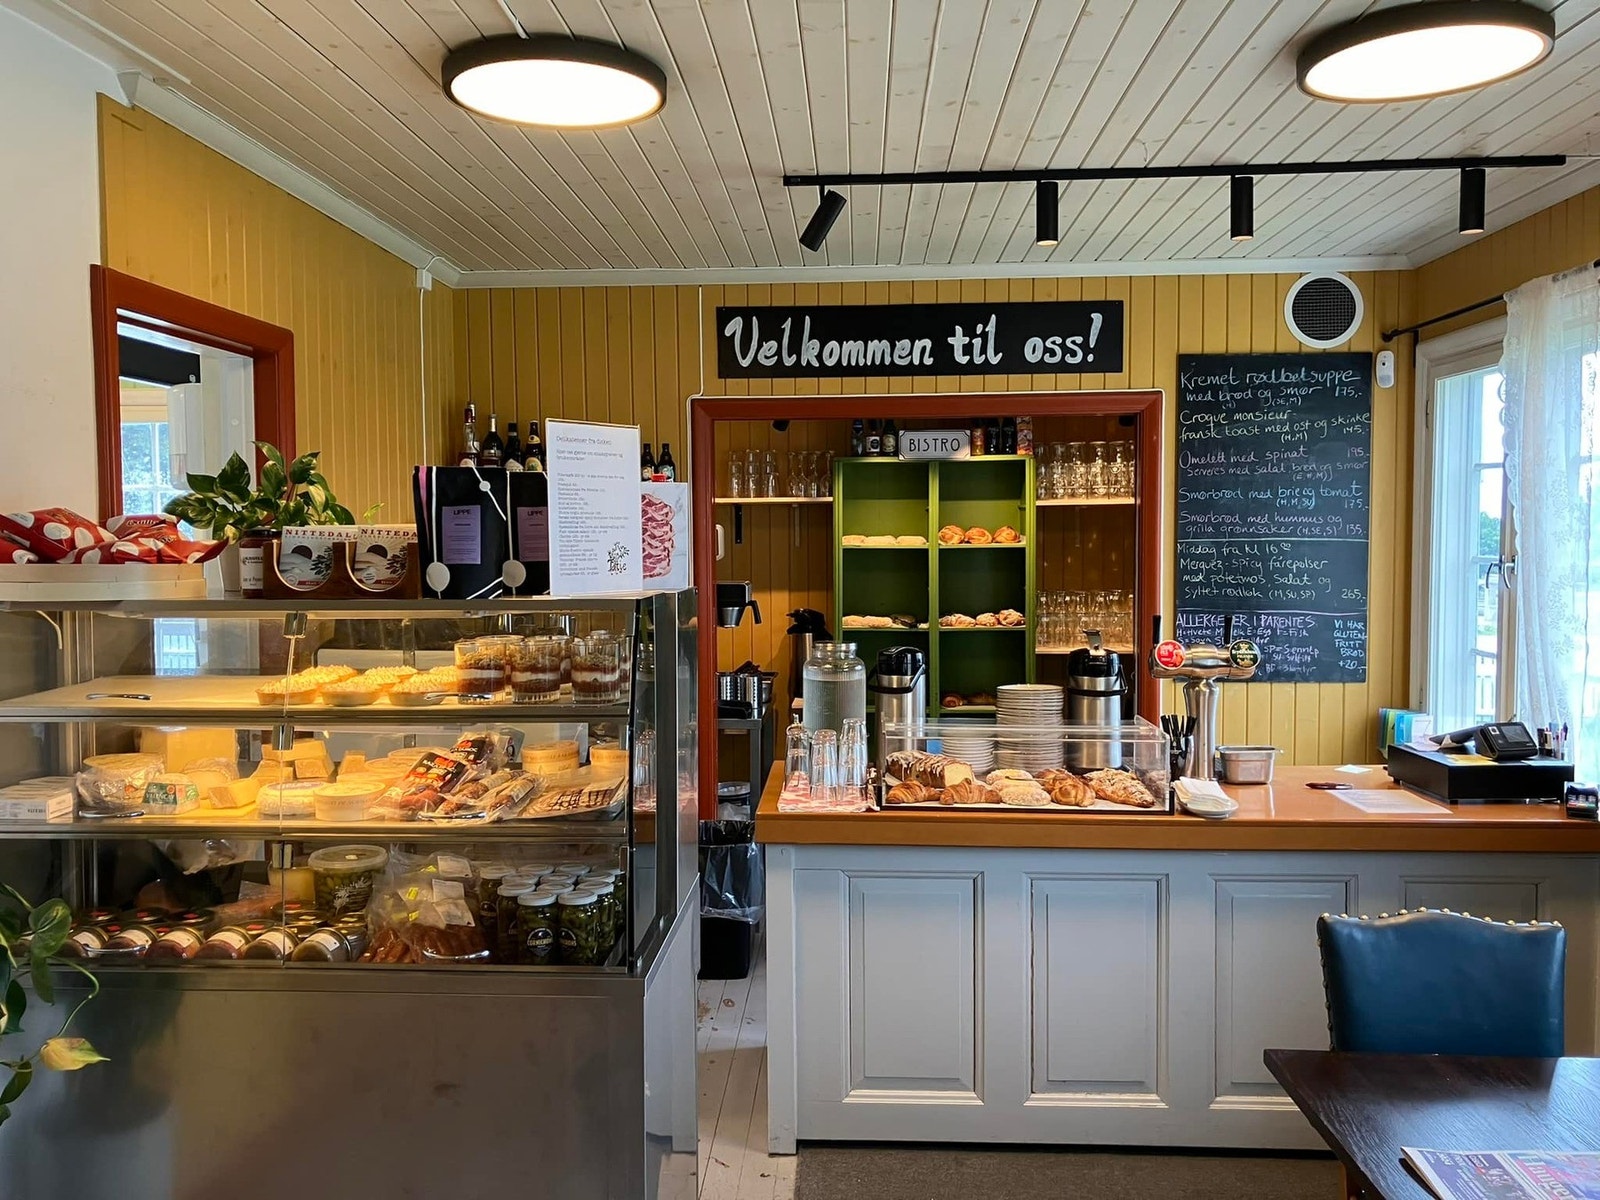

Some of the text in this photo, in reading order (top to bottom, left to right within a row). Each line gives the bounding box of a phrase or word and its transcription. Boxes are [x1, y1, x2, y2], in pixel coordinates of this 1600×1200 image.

[724, 312, 1103, 368] Velkommen til oss!
[1180, 367, 1240, 390] Kremet
[1186, 390, 1215, 402] med
[1257, 388, 1272, 407] og
[1179, 412, 1371, 443] fransk toast med ost og skinke
[1180, 410, 1229, 427] Croque
[909, 438, 961, 452] BISTRO
[1179, 450, 1227, 469] Omelett
[1230, 451, 1260, 463] med
[1264, 445, 1309, 463] spinat
[1228, 464, 1251, 475] med
[1320, 463, 1333, 482] og
[1248, 488, 1273, 499] med
[1278, 485, 1300, 498] brie
[1302, 487, 1316, 510] og
[1320, 480, 1362, 498] tomat
[1246, 513, 1271, 524] med
[1274, 511, 1324, 524] hummus
[1327, 514, 1343, 530] og
[285, 528, 353, 539] NITTEDAL
[1185, 523, 1216, 541] grilla
[1177, 542, 1217, 561] Middag
[1221, 542, 1243, 556] fra
[1182, 572, 1207, 583] med
[1317, 576, 1332, 593] og
[1176, 612, 1250, 628] ALLERGEER
[1333, 619, 1366, 630] VI HAR
[1334, 639, 1359, 648] FRITT
